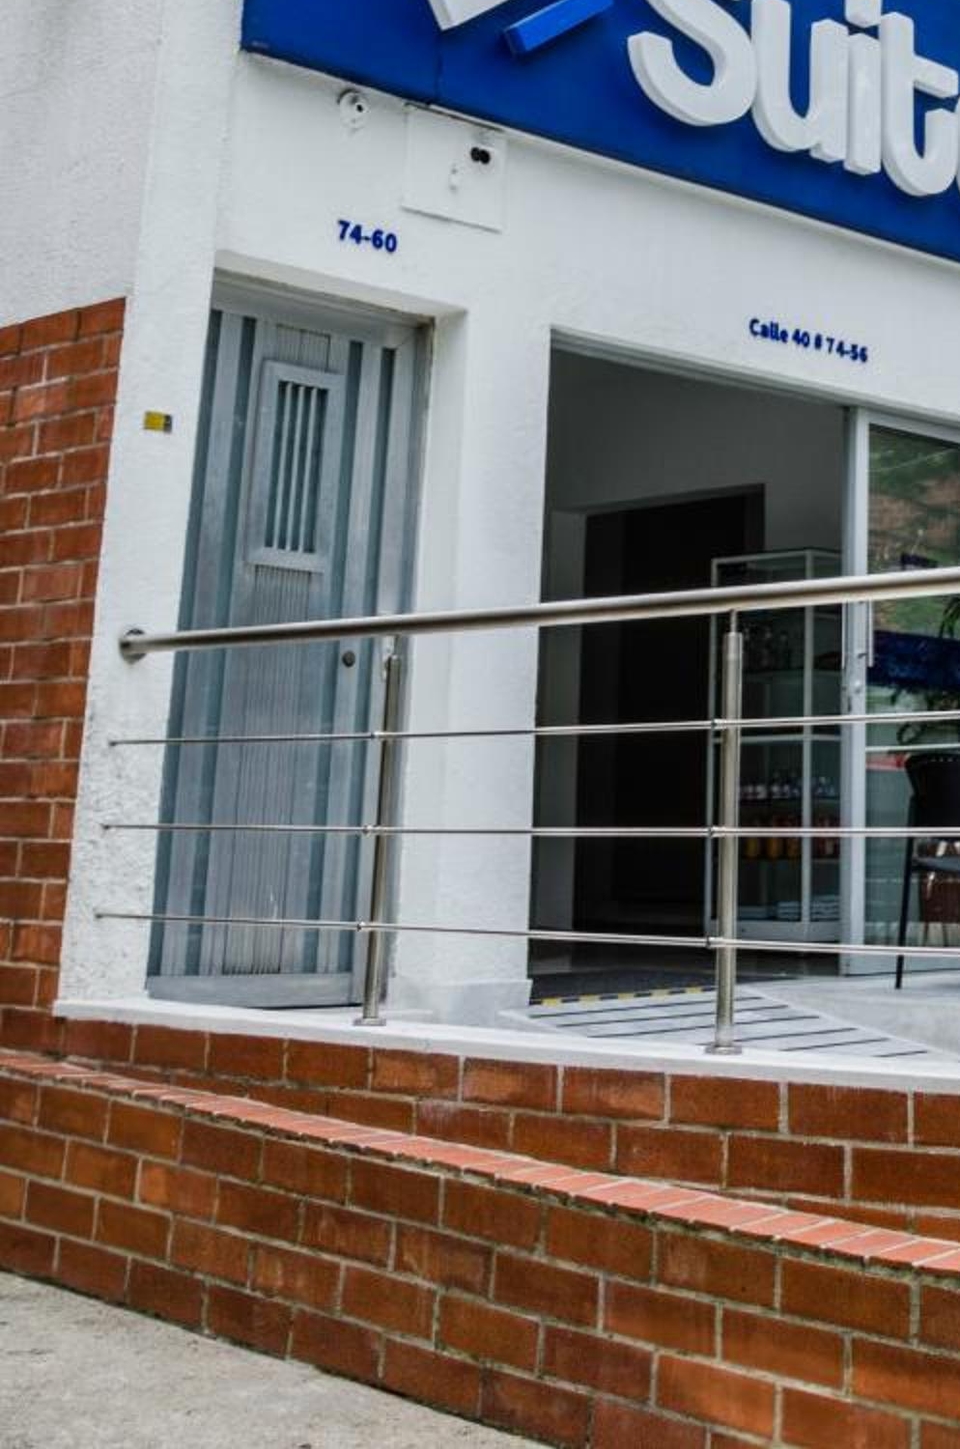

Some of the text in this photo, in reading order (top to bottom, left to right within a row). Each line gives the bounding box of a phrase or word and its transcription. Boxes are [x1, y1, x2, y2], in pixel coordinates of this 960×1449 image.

[337, 219, 398, 254] 74-60
[749, 318, 788, 343] Calle
[792, 328, 810, 348] 40
